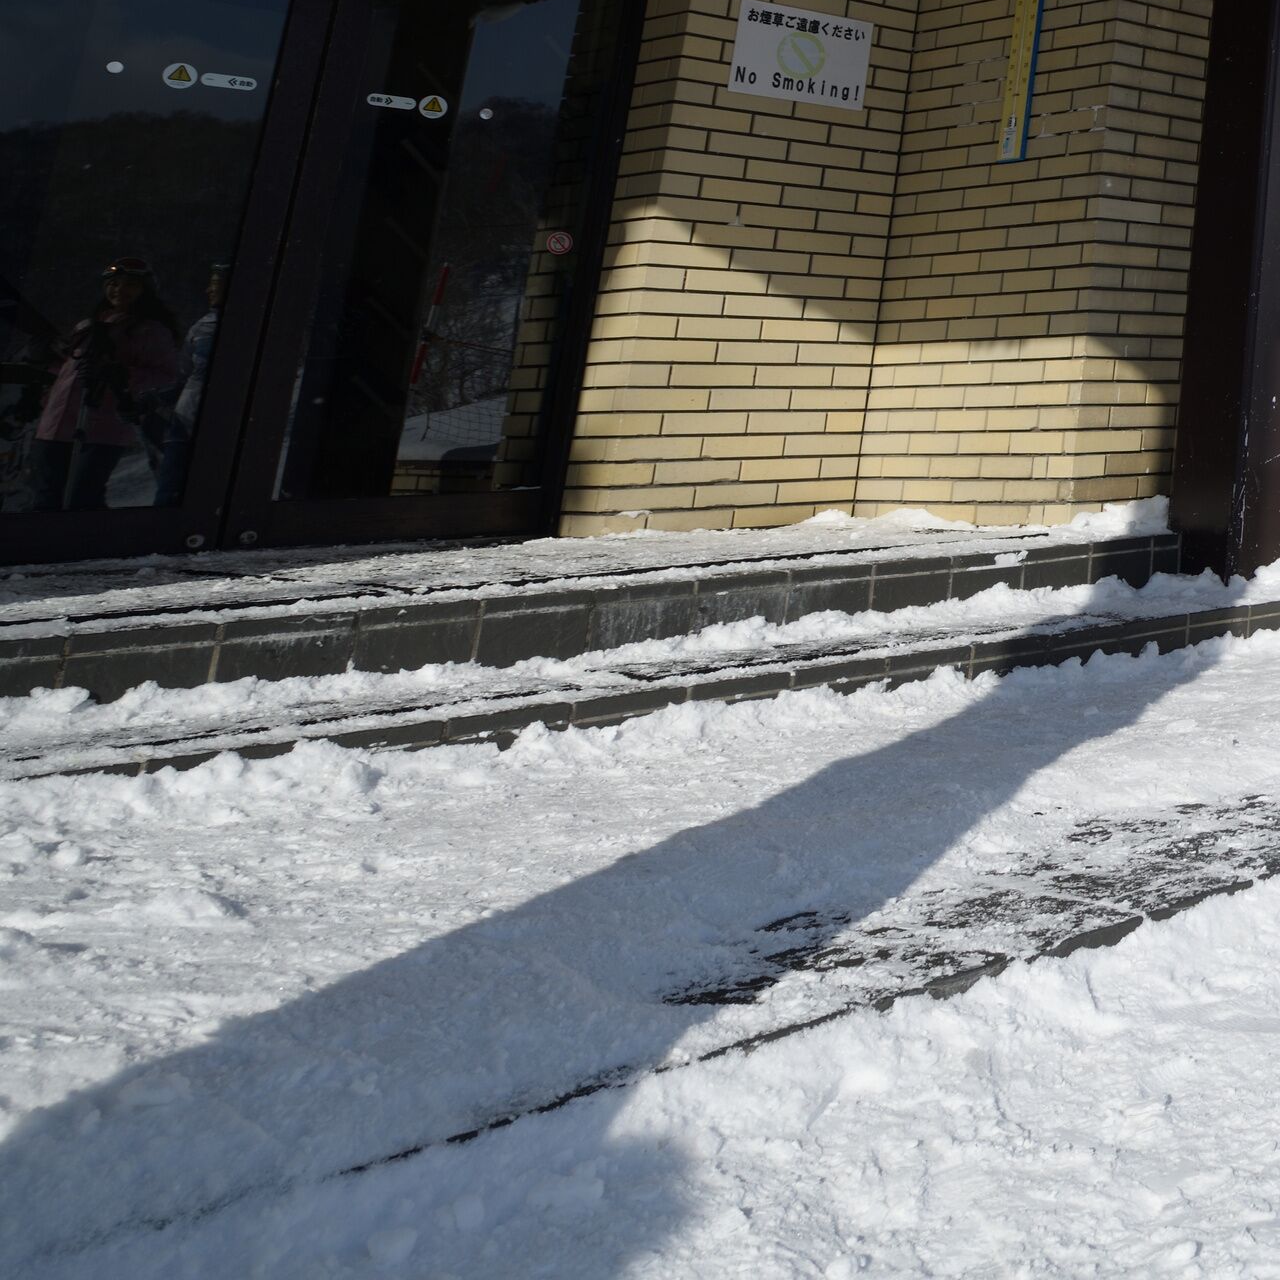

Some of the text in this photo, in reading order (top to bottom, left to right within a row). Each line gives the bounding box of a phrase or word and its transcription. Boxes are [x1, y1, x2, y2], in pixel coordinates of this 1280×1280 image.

[747, 8, 866, 42] お煙草ご遠慮ください
[734, 66, 860, 101] No Smoking!
